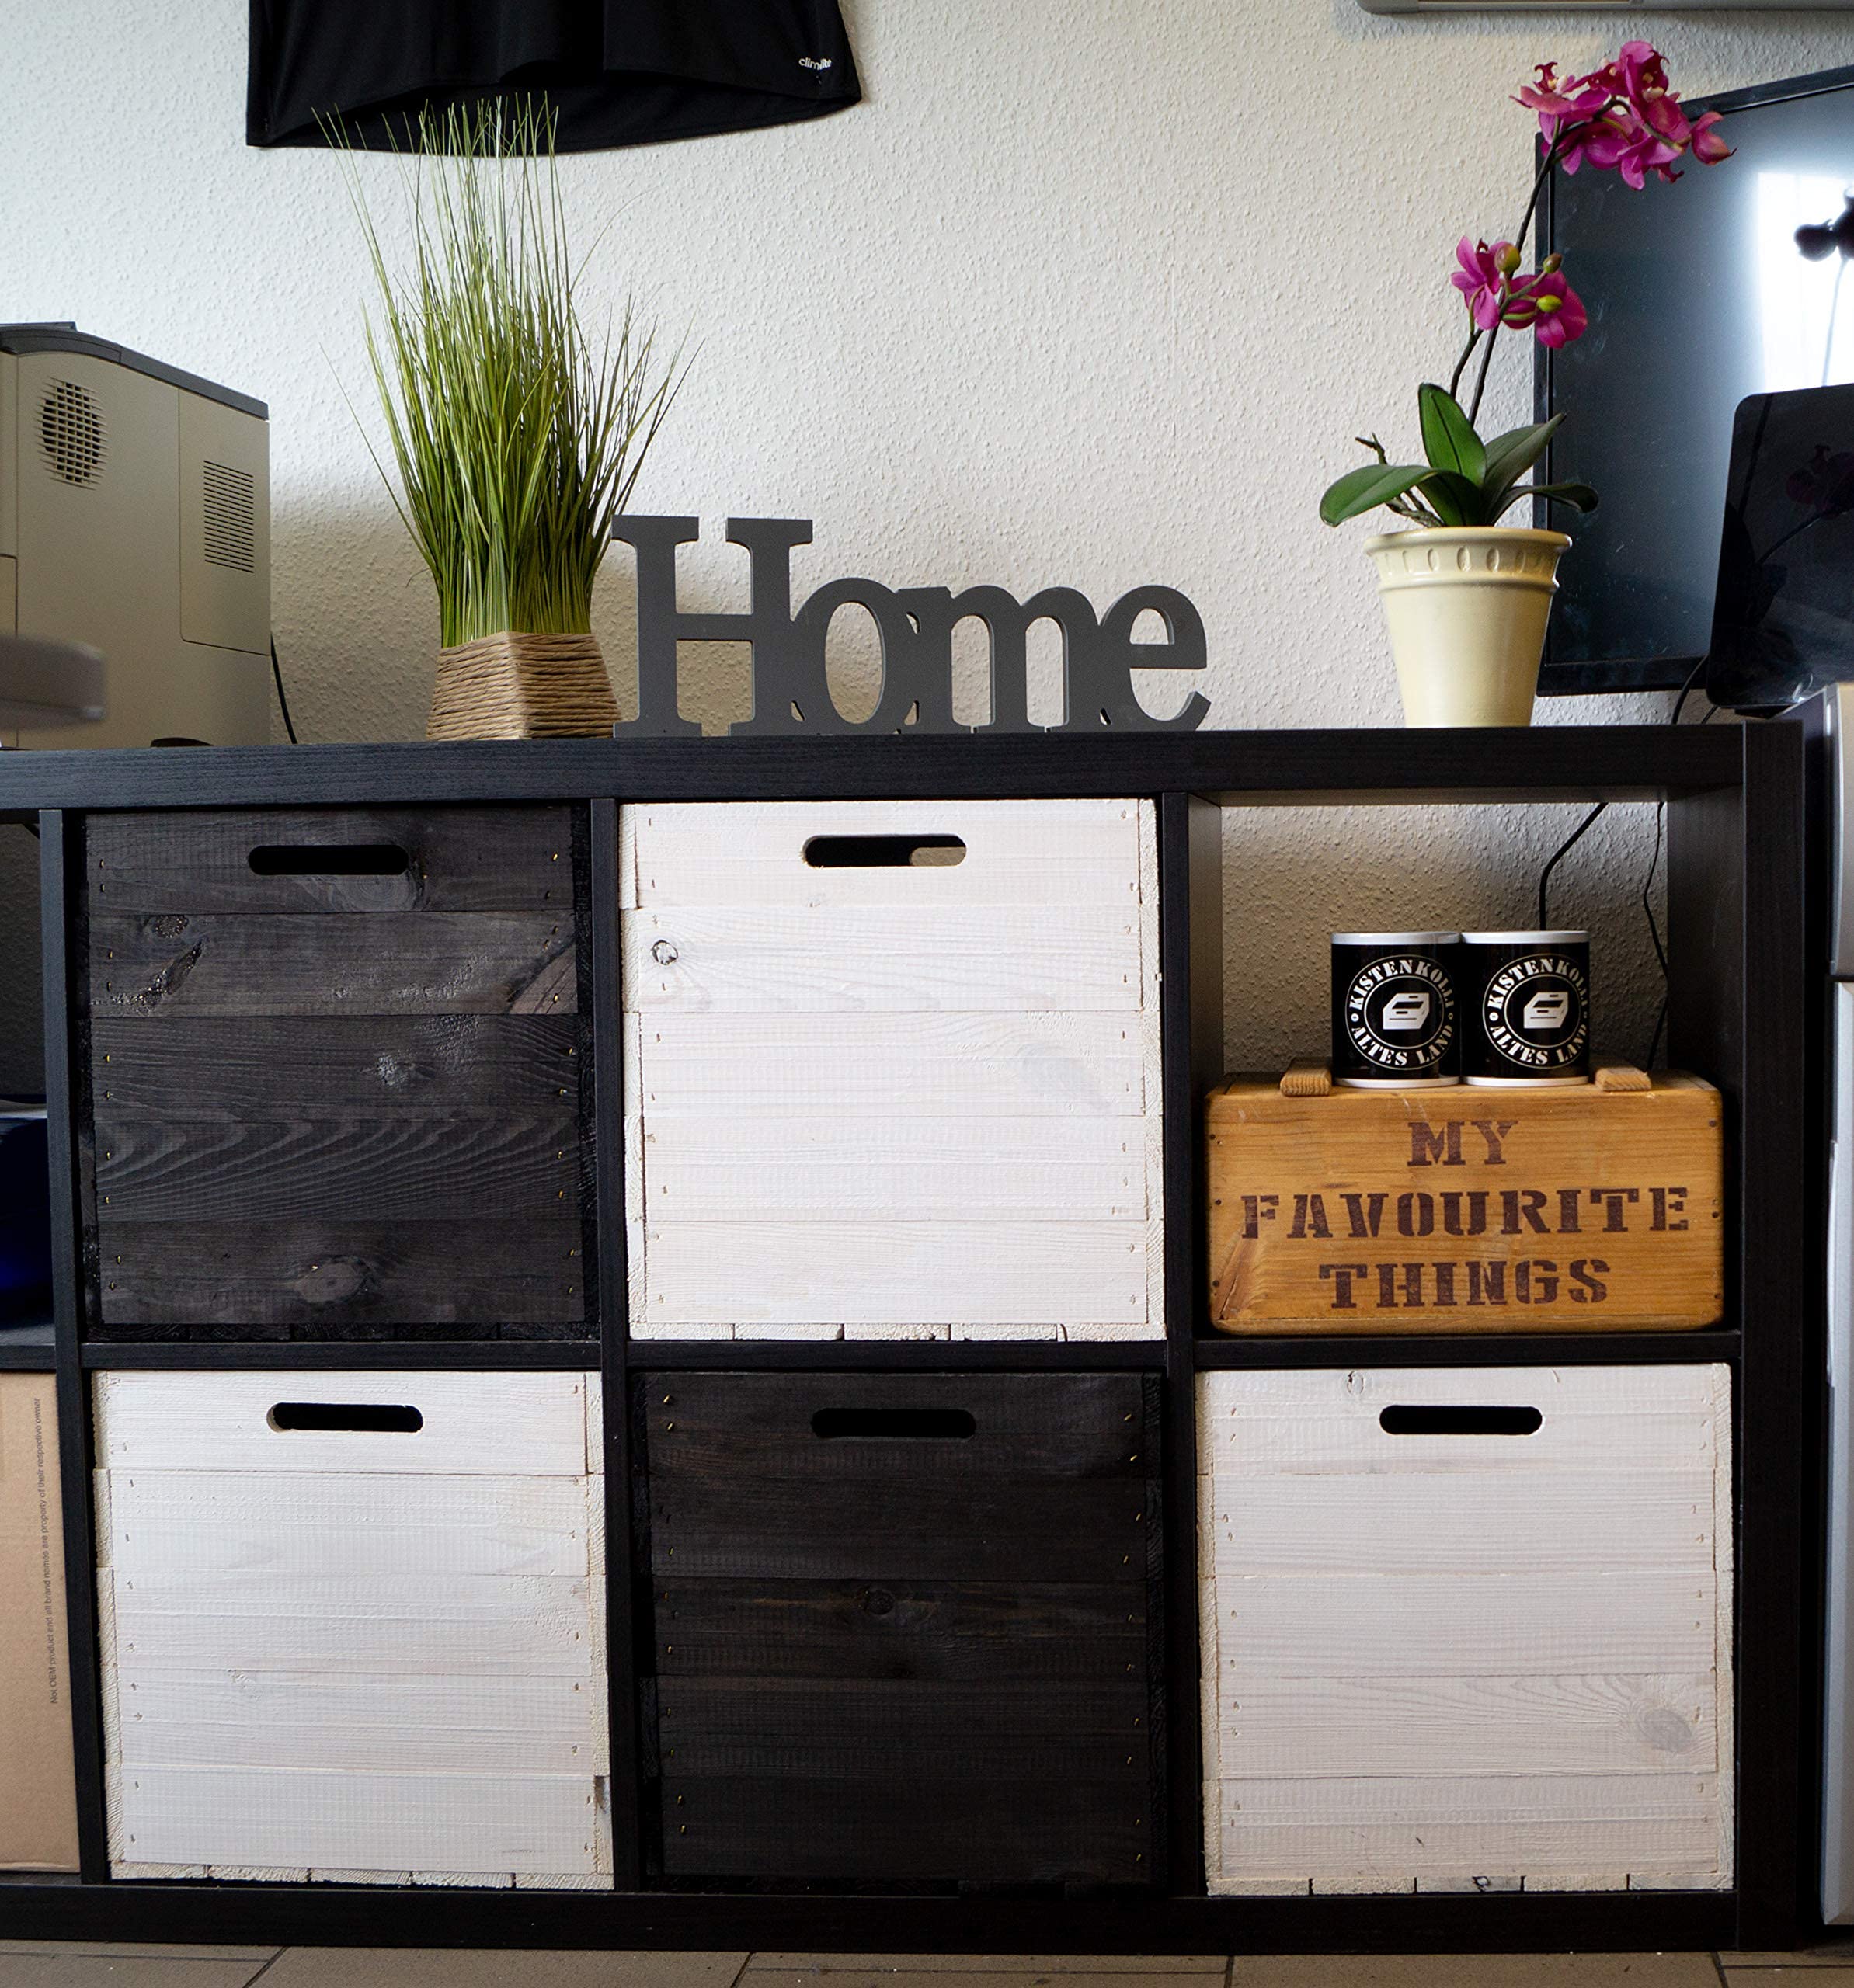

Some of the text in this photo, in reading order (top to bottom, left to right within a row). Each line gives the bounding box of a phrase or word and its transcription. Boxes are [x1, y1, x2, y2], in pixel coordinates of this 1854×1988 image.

[610, 515, 1211, 737] Home
[1349, 959, 1455, 1010] KISTENKOLLI
[1351, 1024, 1453, 1066] ALTES LAND
[1490, 1024, 1587, 1065] ALTES LAND
[1407, 1121, 1518, 1166] MY
[1240, 1187, 1689, 1239] FAVOURITE
[1319, 1259, 1611, 1309] THINGS
[36, 1426, 45, 1467] respective
[40, 1500, 49, 1534] property
[45, 1617, 54, 1632] and
[47, 1634, 56, 1664] product
[50, 1689, 58, 1704] Not
